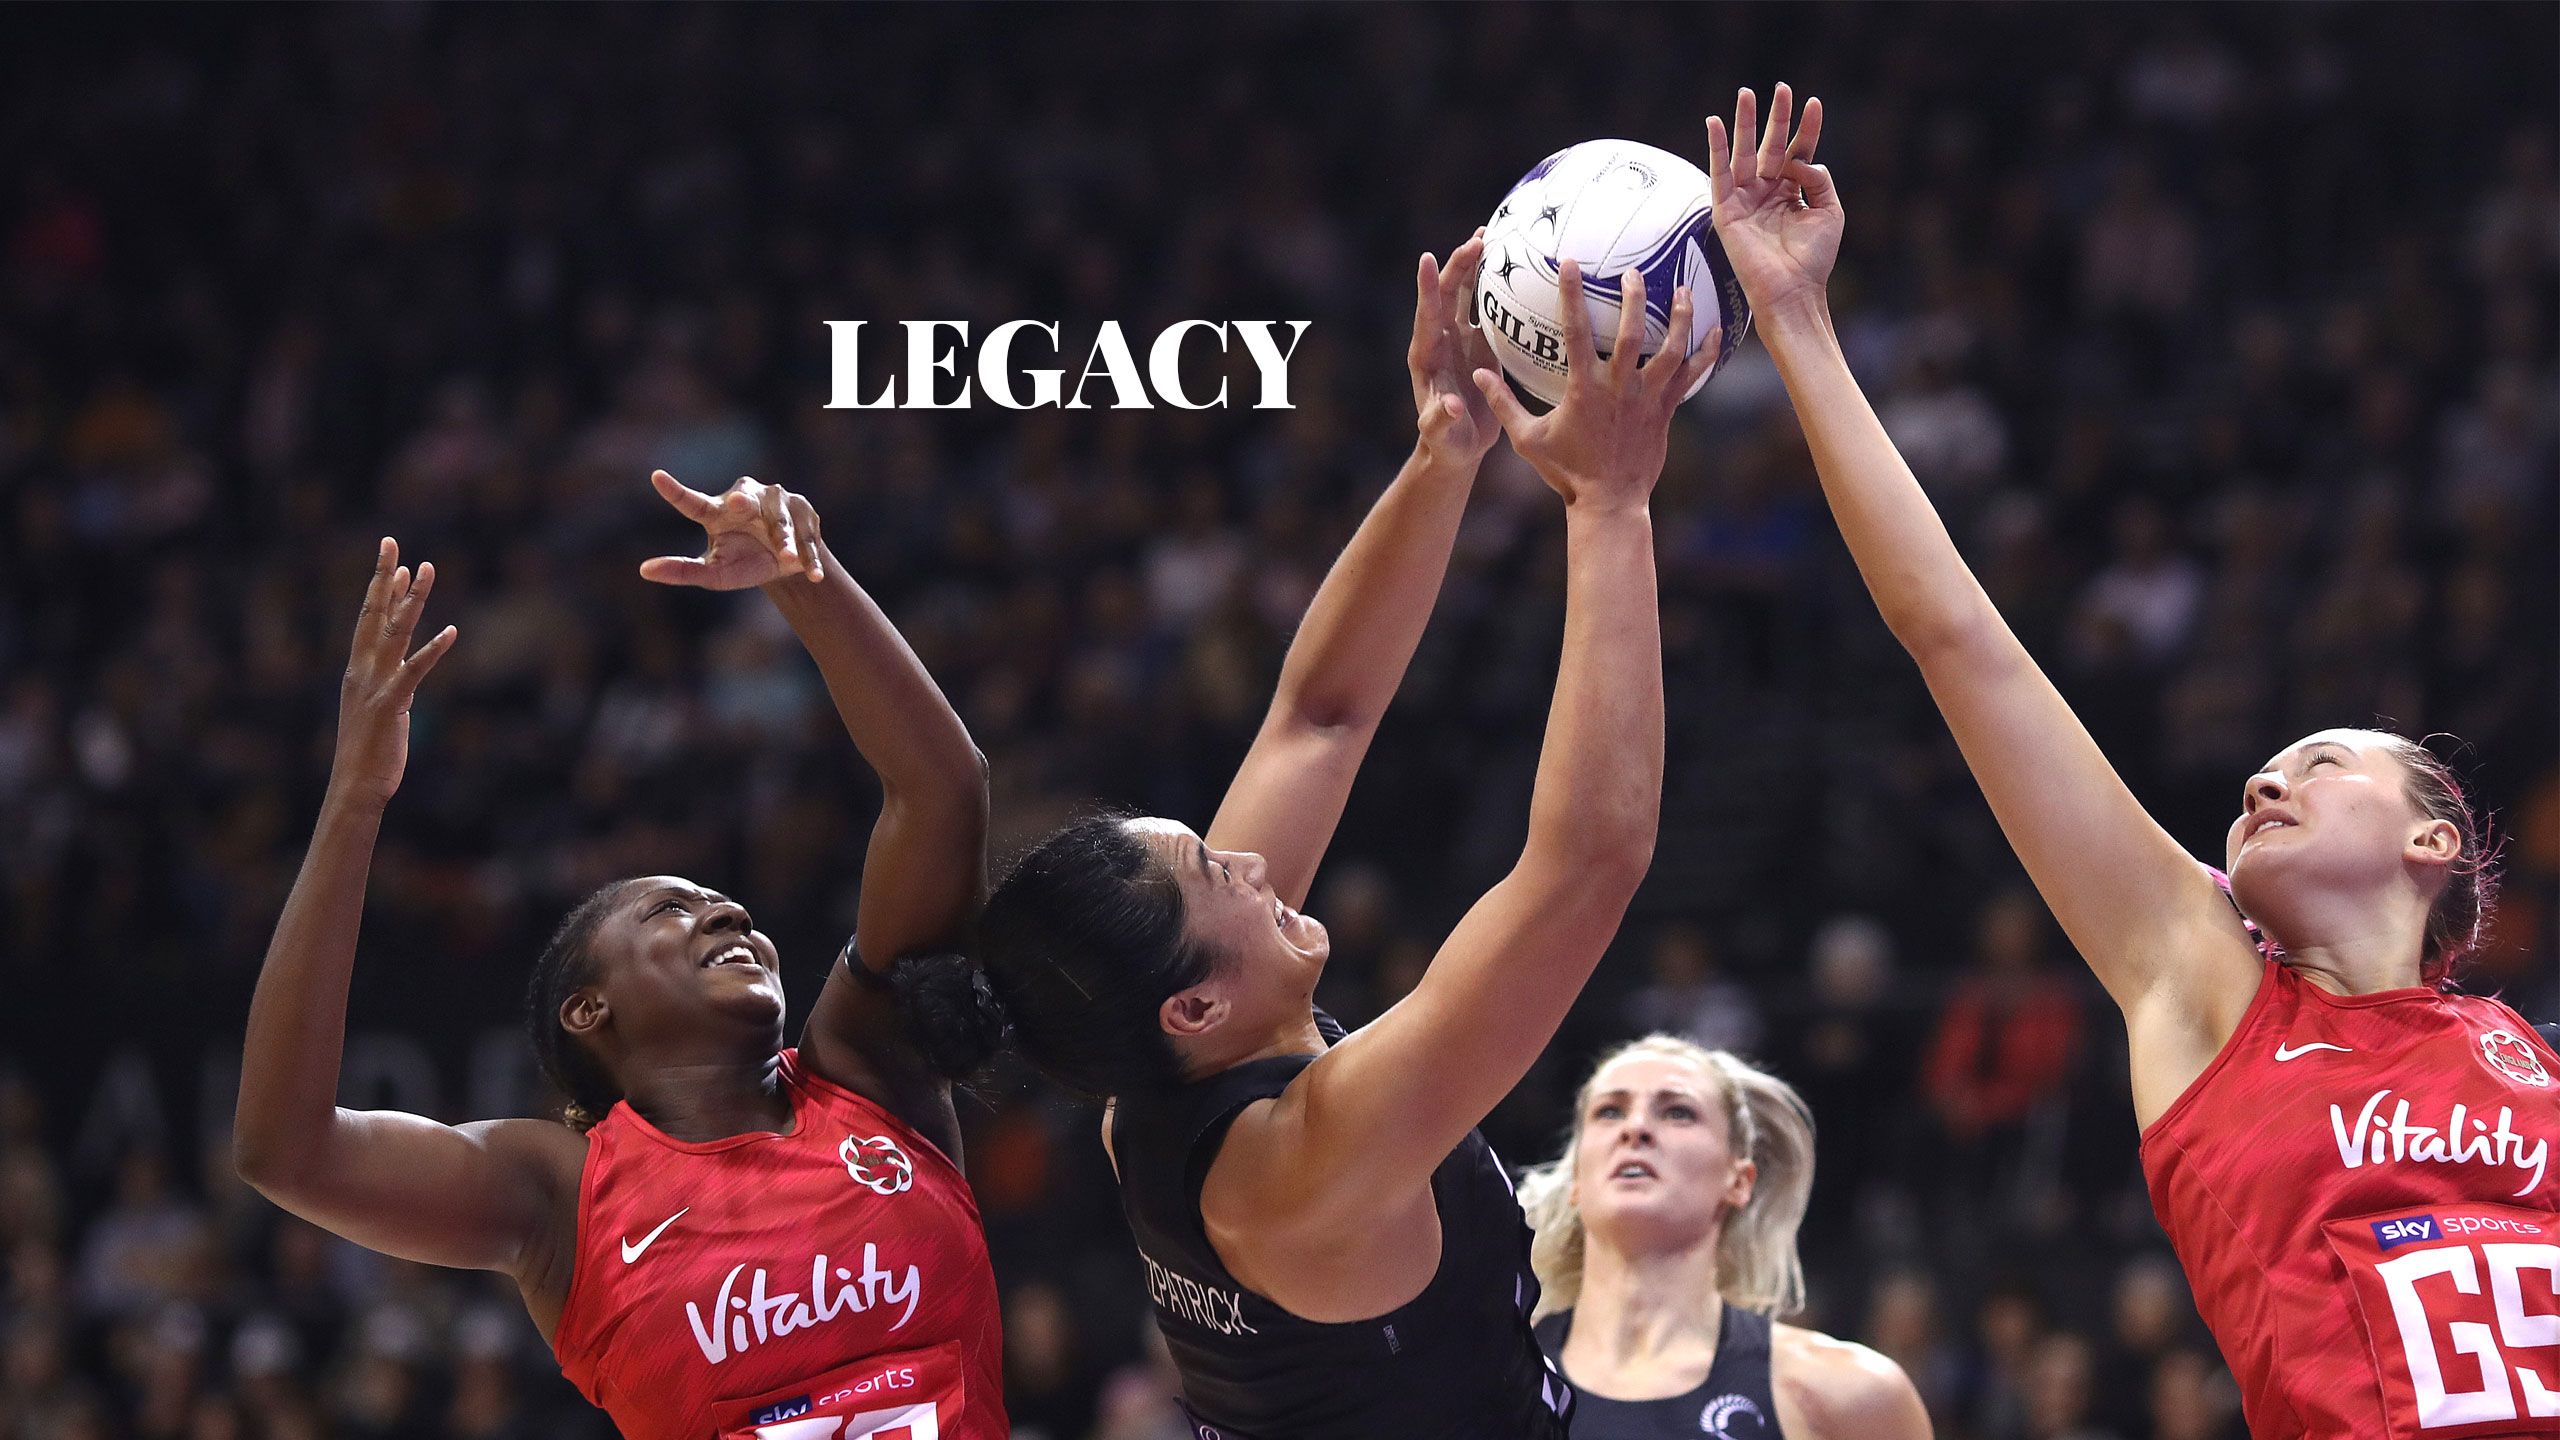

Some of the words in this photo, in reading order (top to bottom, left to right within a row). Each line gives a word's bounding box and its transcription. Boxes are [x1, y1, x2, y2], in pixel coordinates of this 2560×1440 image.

[2330, 1089, 2548, 1197] Vitality
[2381, 1220, 2431, 1240] sky
[2443, 1216, 2542, 1235] sports
[686, 1242, 921, 1365] Vitality
[1138, 1245, 1258, 1336] ZPATRICK
